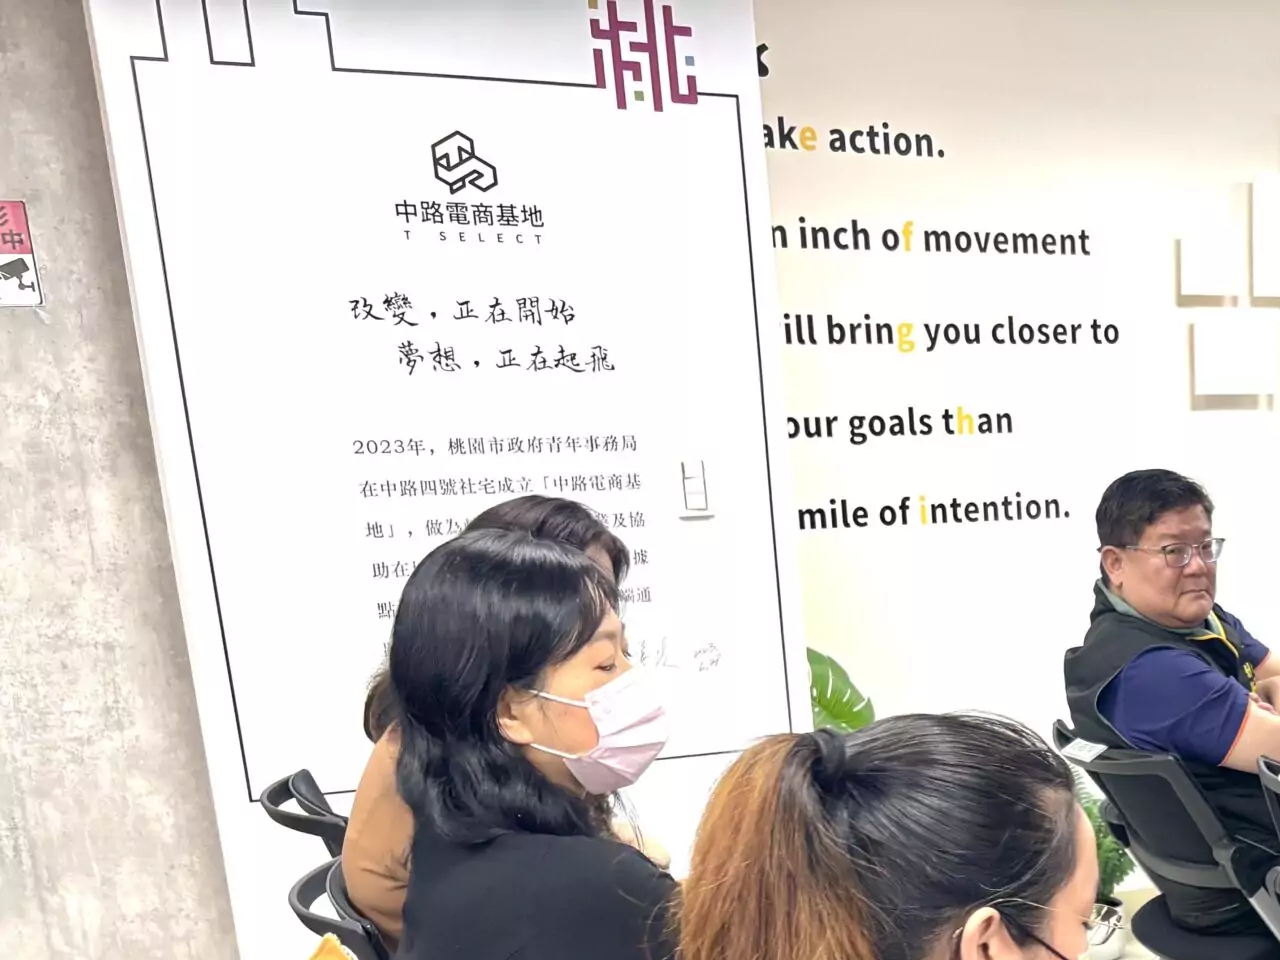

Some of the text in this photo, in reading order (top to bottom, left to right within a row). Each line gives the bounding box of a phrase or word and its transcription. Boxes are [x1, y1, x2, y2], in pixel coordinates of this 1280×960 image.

[763, 116, 945, 159] ake action.
[395, 199, 545, 228] 中路電商基地
[403, 230, 542, 245] T SELECT
[798, 215, 871, 251] inch
[881, 221, 914, 253] of
[923, 229, 1091, 256] movement
[783, 312, 1120, 354] ill bring you closer to
[848, 406, 933, 446] goals
[941, 406, 1013, 436] than
[797, 491, 1070, 531] mile of intention.
